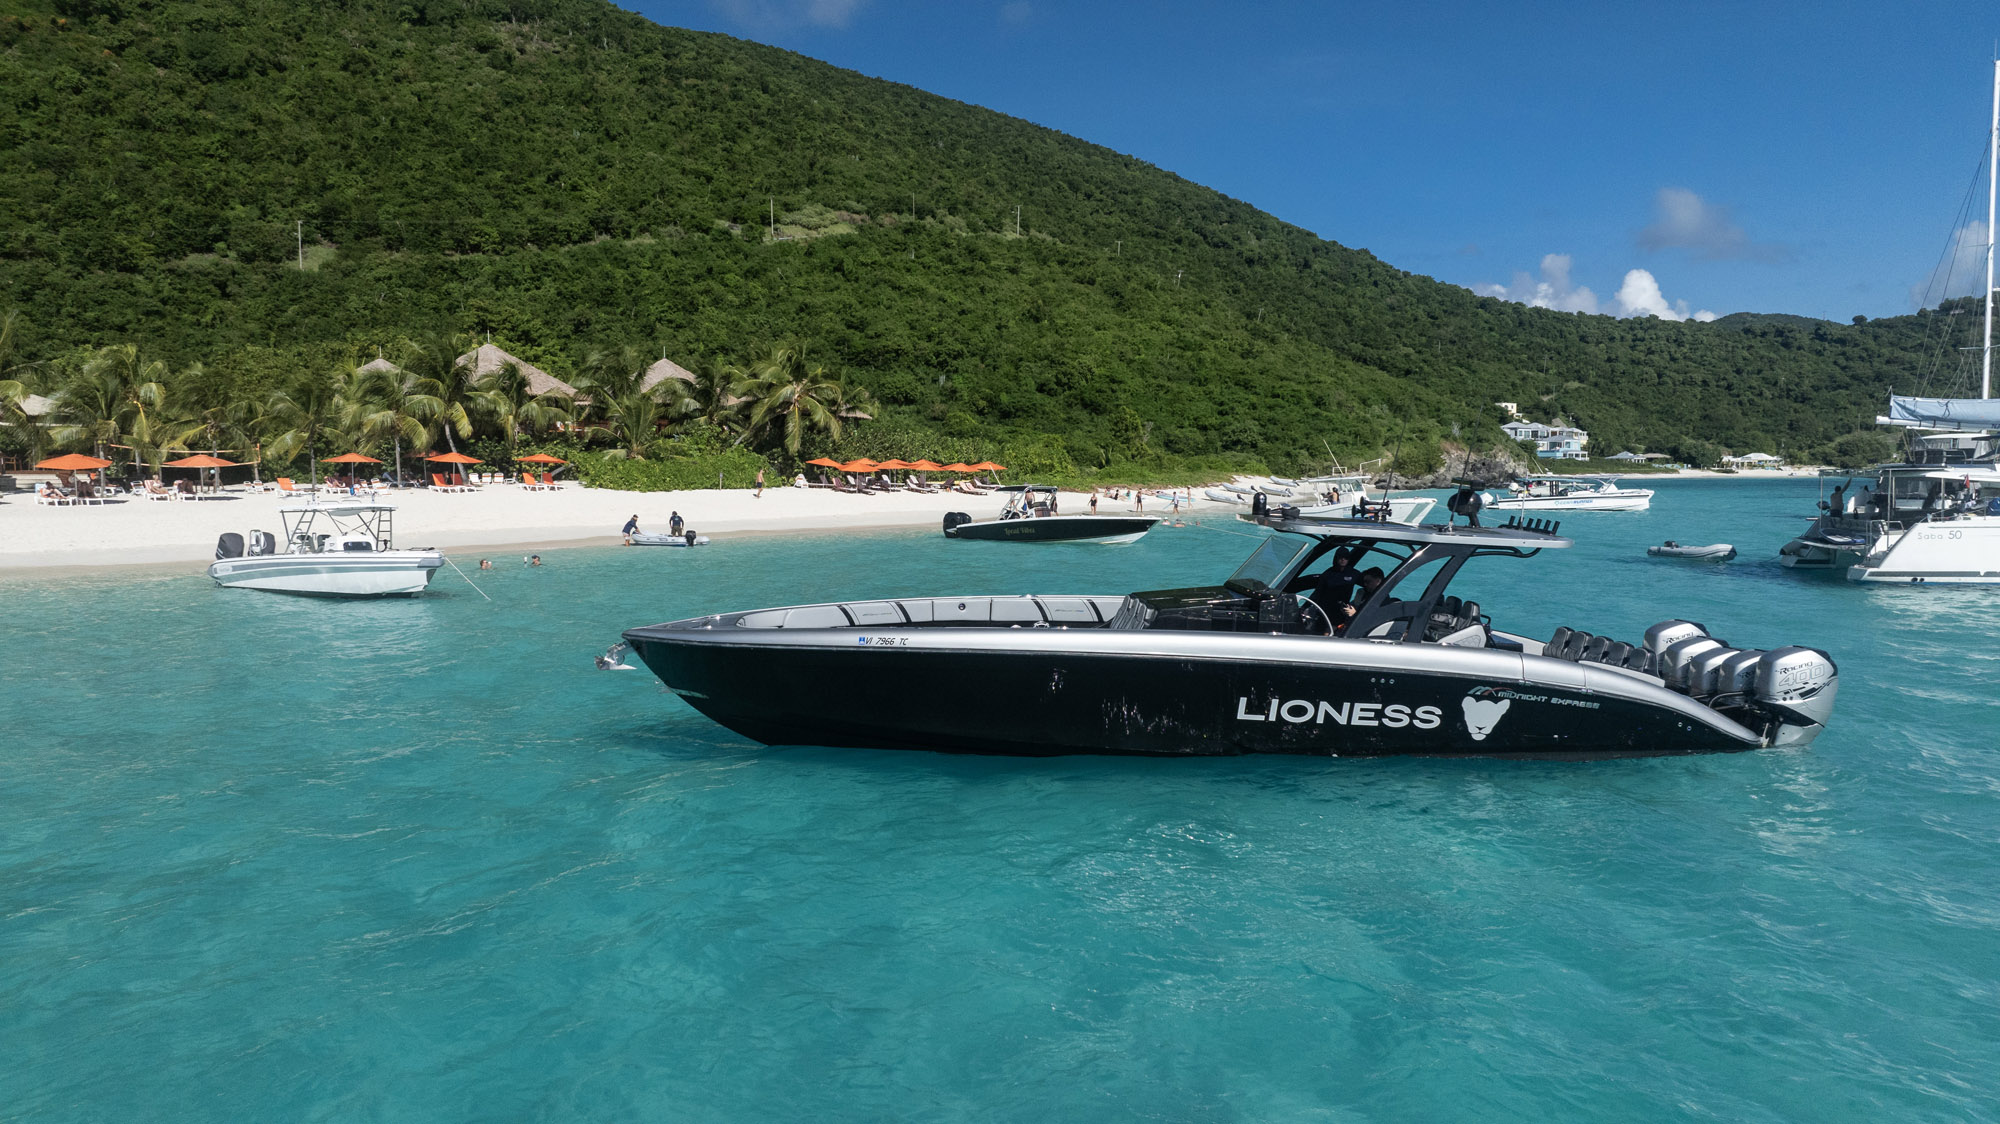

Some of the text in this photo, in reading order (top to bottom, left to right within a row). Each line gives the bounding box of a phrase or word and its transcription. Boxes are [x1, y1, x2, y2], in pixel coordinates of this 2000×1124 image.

[1917, 530, 1963, 540] Saba 50
[865, 637, 908, 646] VI 7966 TC
[1779, 661, 1813, 675] Racing
[1778, 664, 1825, 687] 400
[1550, 697, 1601, 709] EXPRESS
[1236, 696, 1443, 730] LIONESS
